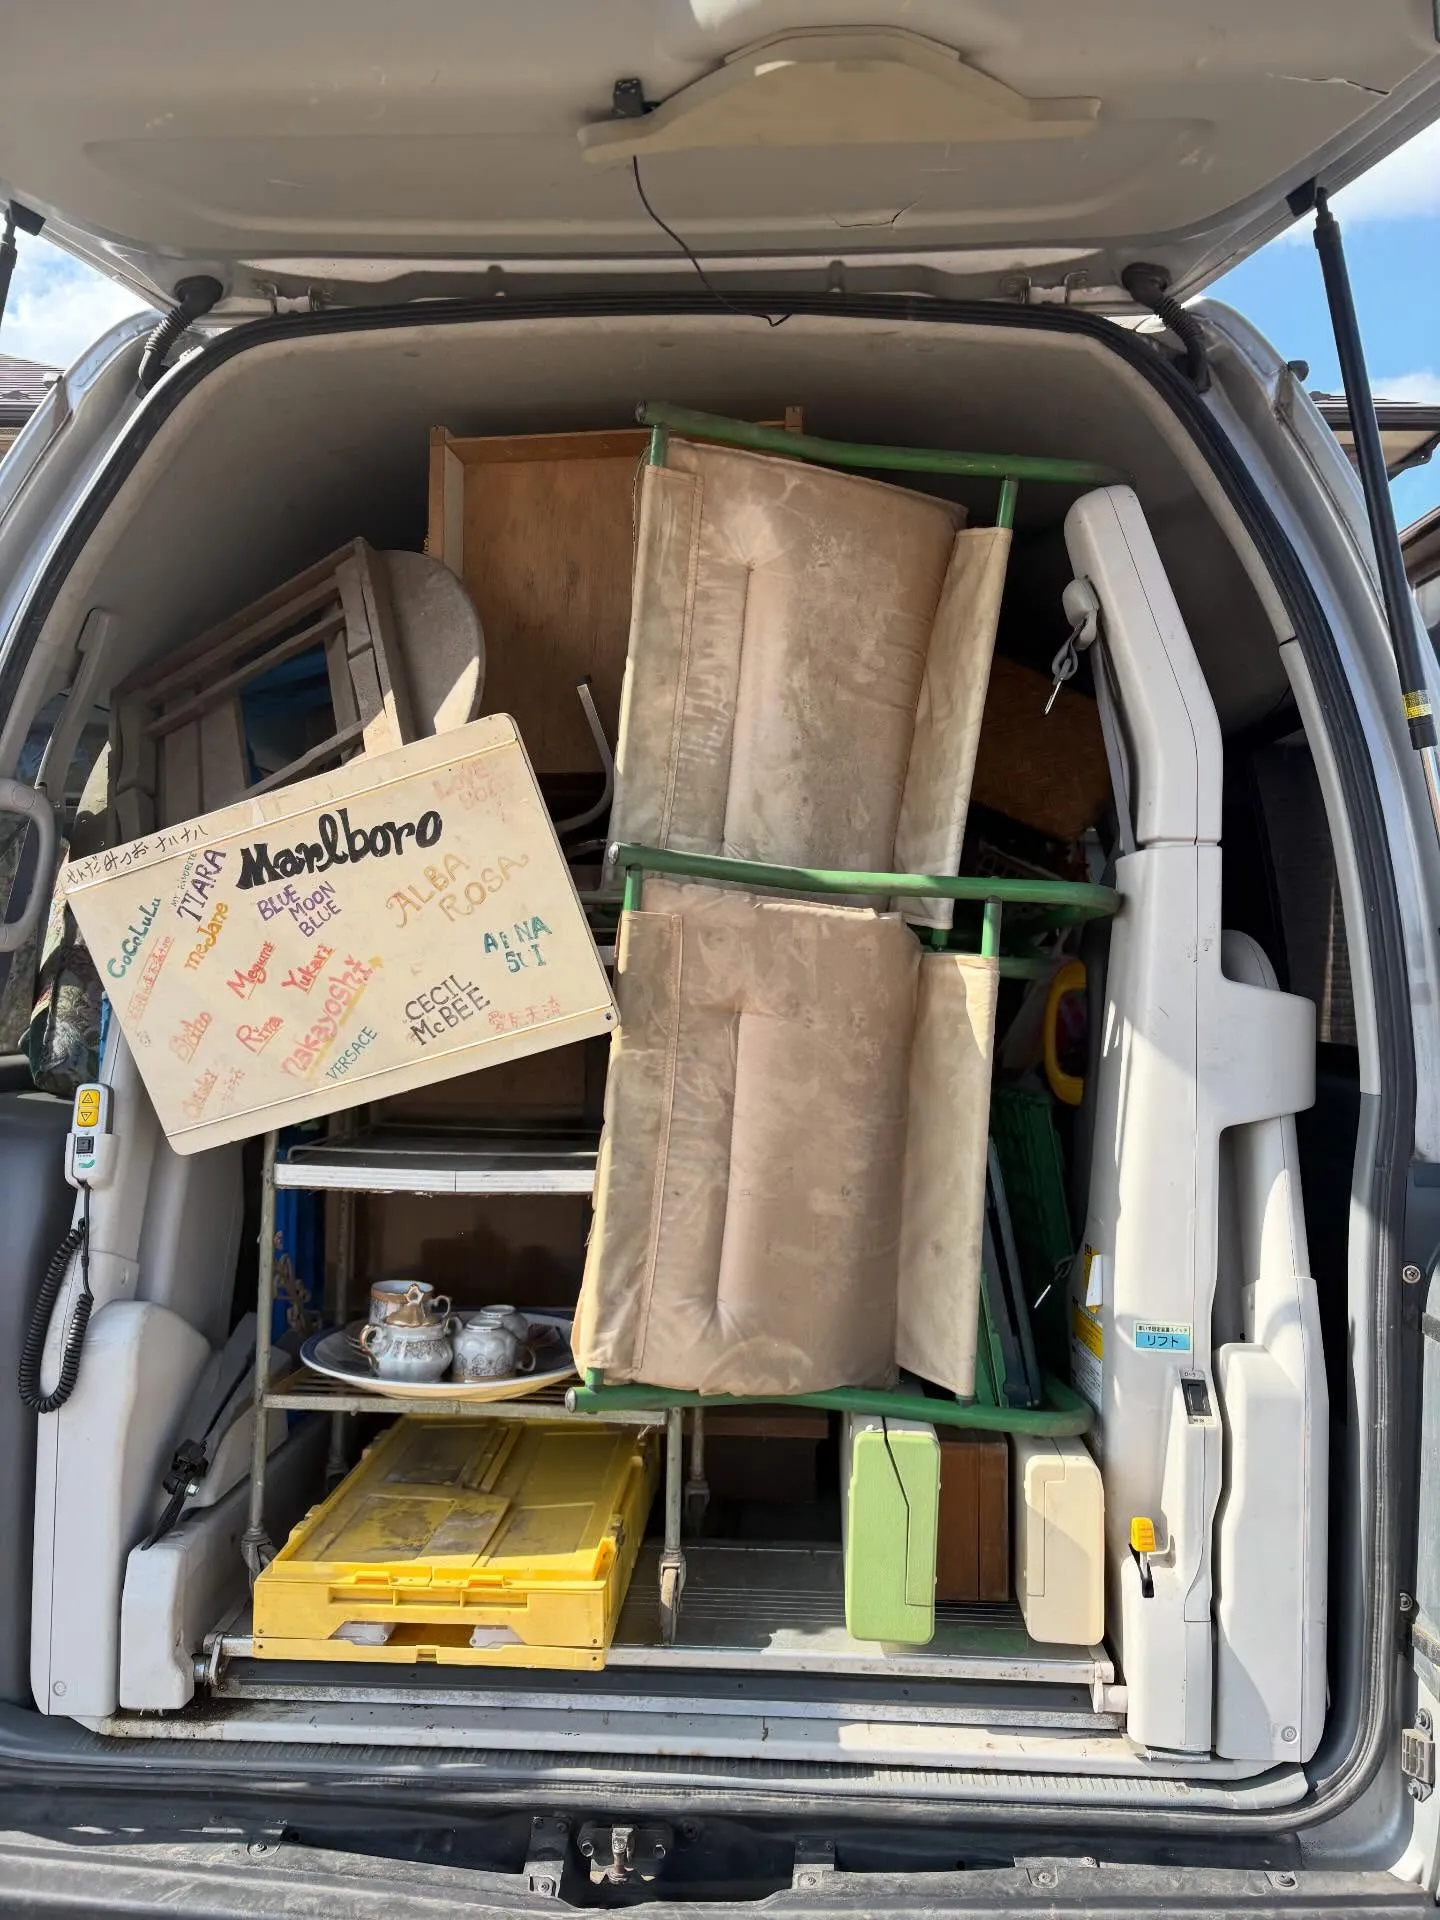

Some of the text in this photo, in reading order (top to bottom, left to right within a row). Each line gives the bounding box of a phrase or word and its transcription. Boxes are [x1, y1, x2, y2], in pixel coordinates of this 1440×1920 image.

[66, 824, 209, 885] せんだみつお ナハナハ
[236, 808, 443, 890] Marlboro
[176, 849, 227, 922] TIARA
[256, 883, 300, 921] BLUE
[288, 880, 336, 922] MOON
[385, 853, 470, 928] ALBA
[438, 854, 529, 922] ROSA
[298, 900, 342, 937] BLUE
[281, 943, 334, 993] Yukari
[404, 974, 472, 1021] CECIL
[410, 986, 491, 1046] McBEE
[325, 1025, 378, 1081] VERSACE
[1147, 1335, 1178, 1348] リフト
